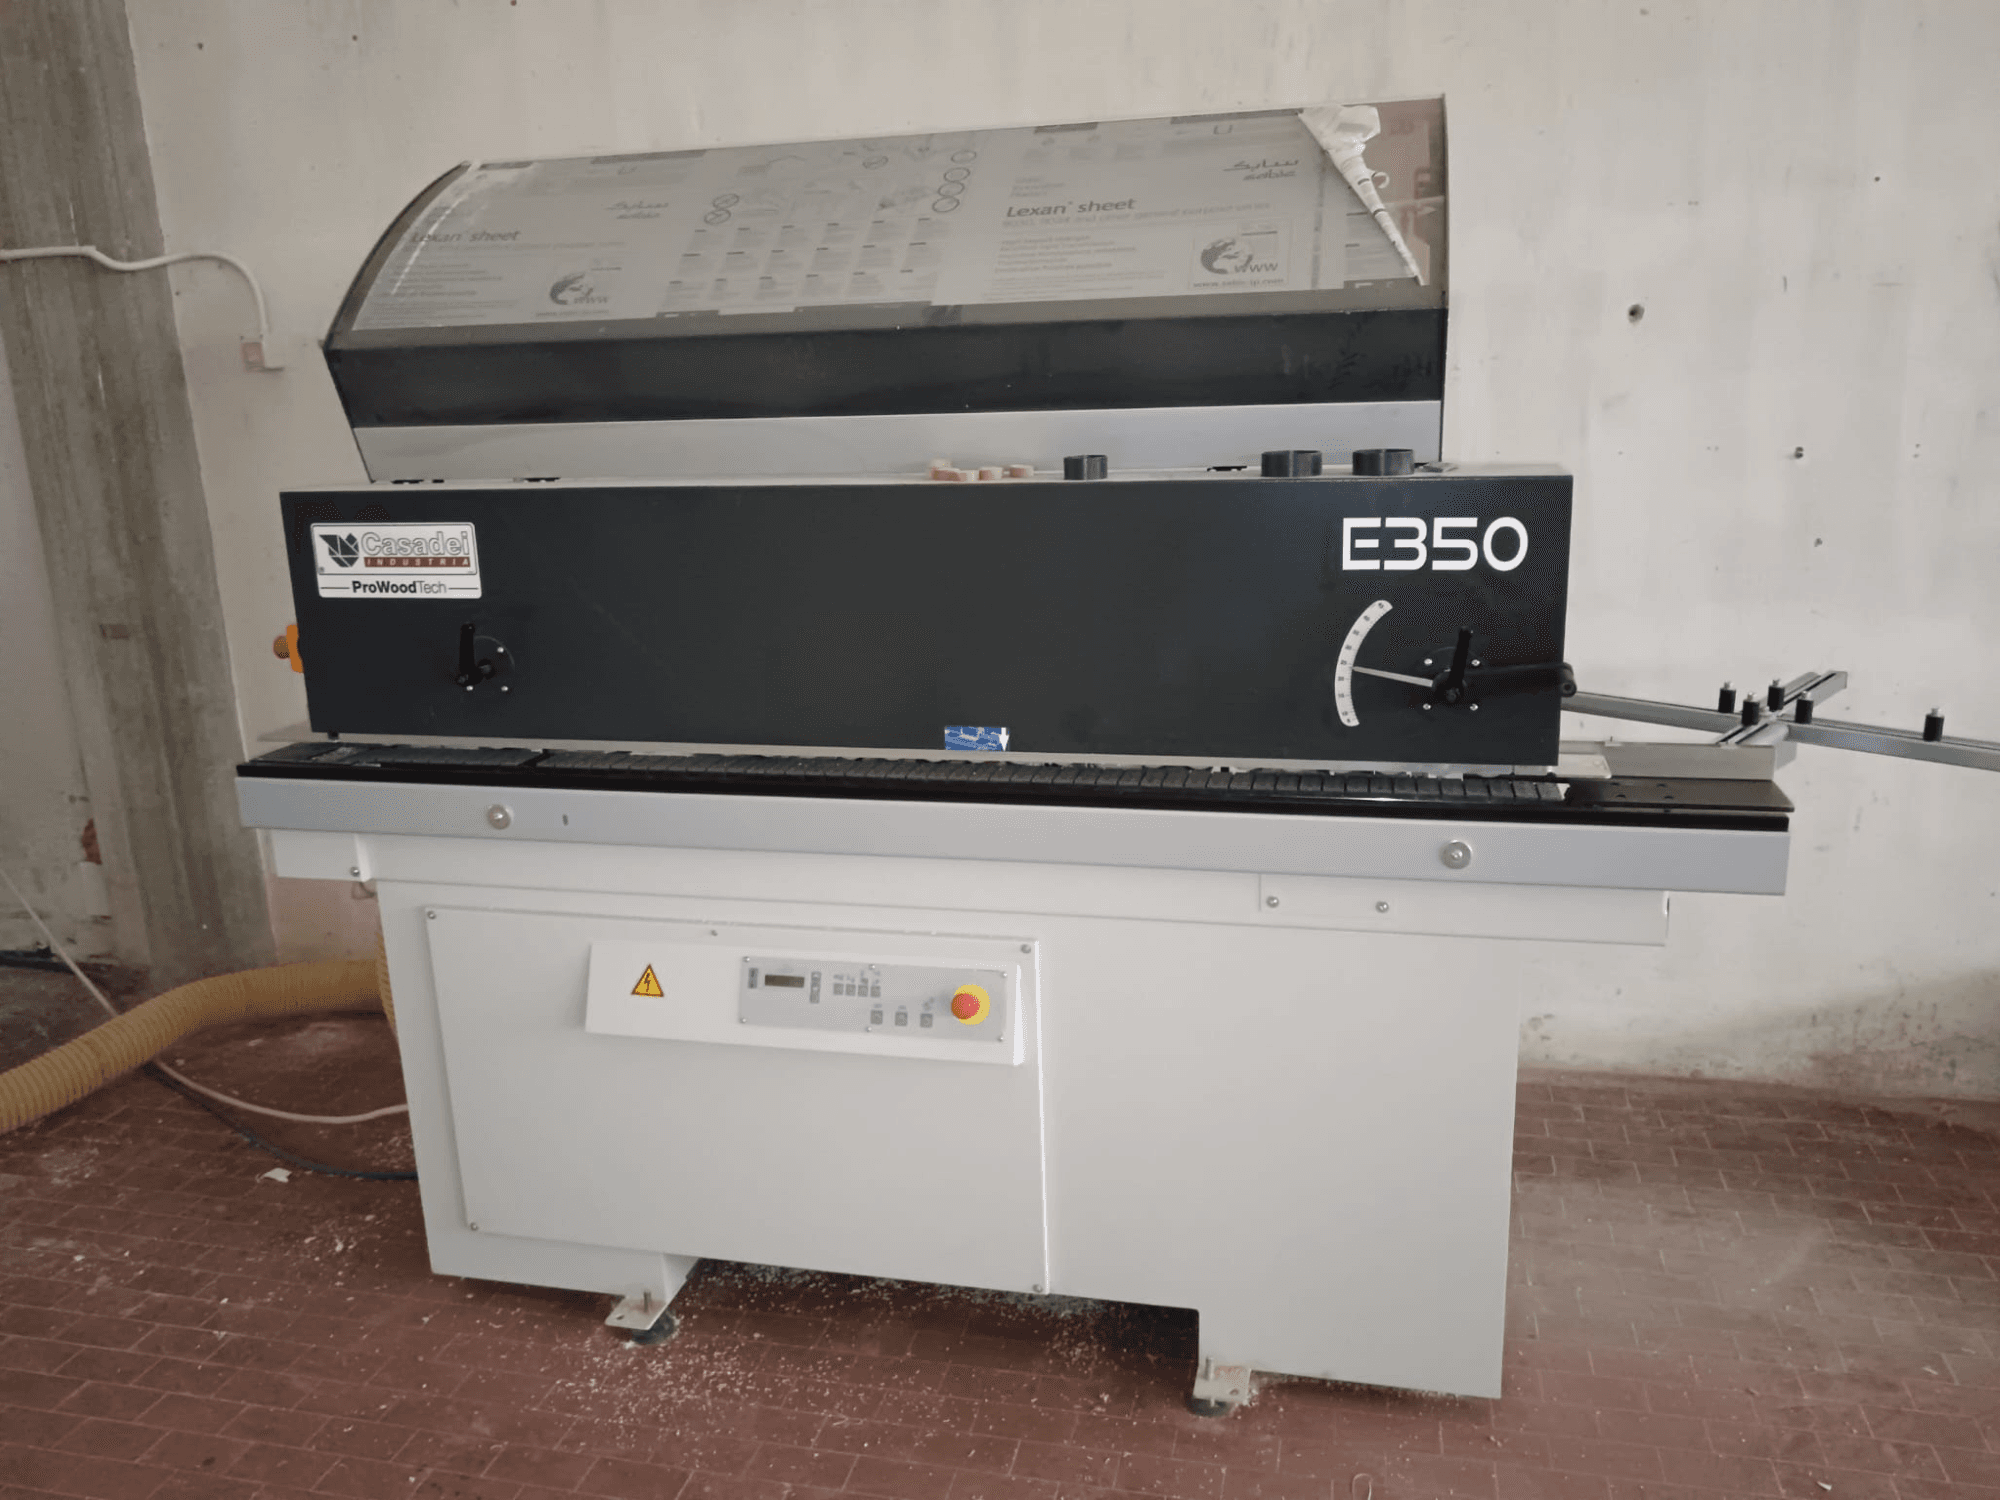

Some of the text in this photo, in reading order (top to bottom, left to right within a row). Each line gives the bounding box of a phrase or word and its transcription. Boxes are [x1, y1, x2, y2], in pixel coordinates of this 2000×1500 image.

[1077, 198, 1136, 213] sheet
[469, 229, 521, 242] sheet
[361, 530, 471, 556] Casadei
[1342, 516, 1529, 572] E350
[366, 557, 470, 568] INDUSTRIA
[352, 580, 447, 594] ProWoodTech
